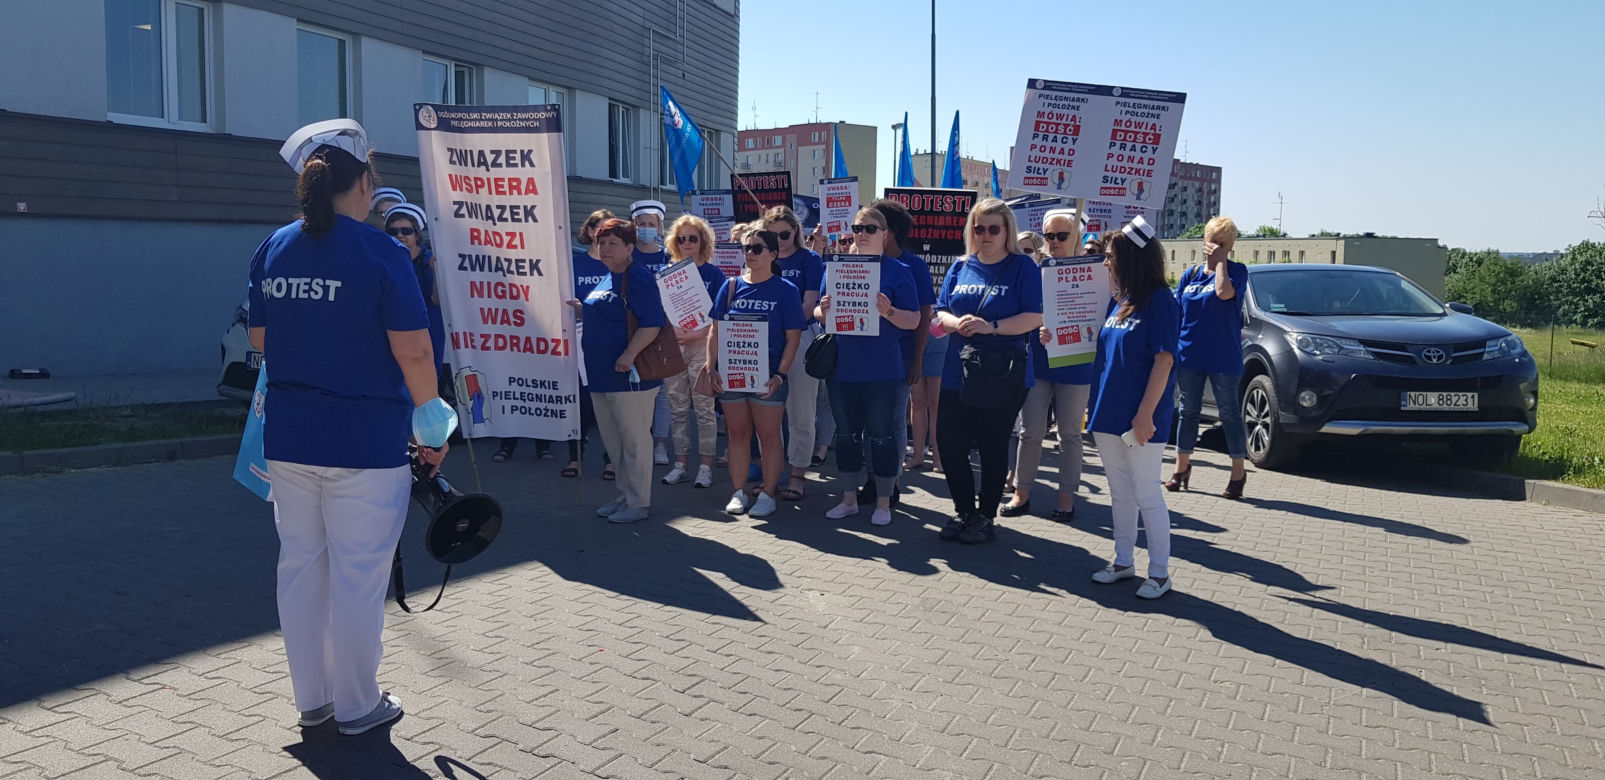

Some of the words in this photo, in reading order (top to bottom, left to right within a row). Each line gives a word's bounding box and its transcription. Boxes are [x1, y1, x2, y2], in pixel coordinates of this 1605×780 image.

[1038, 94, 1088, 104] PIELĘGNIARKI
[1047, 103, 1080, 111] POŁOŻNE
[1115, 100, 1169, 112] PIELĘGNIARKI
[438, 111, 480, 120] OGÓLNOPOLSKI
[482, 112, 512, 120] ZWIĄZEK
[1036, 110, 1082, 124] MÓWIĄ:
[1124, 110, 1161, 119] POŁOŻNE
[1039, 123, 1074, 135] DOŚĆ
[1113, 118, 1162, 132] MÓWIĄ:
[1032, 133, 1078, 145] PRACY
[1116, 132, 1154, 143] DOŚĆ
[1030, 144, 1075, 156] PONAD
[1108, 141, 1160, 154] PRACY
[447, 147, 535, 172] ZWIĄZEK
[1028, 155, 1074, 168] LUDZKIE
[1106, 153, 1155, 165] PONAD
[1025, 166, 1048, 176] SIŁY
[1104, 164, 1154, 177] LUDZKIE
[448, 174, 539, 196] WSPIERA
[734, 175, 788, 190] PROTEST!
[1102, 175, 1127, 186] SIŁY
[453, 201, 539, 226] ZWIĄZEK
[470, 228, 525, 250] RADZI
[458, 253, 543, 277] ZWIĄZEK
[1058, 266, 1092, 275] GODNA
[664, 269, 687, 284] GODNA
[1058, 274, 1093, 283] PŁACA
[262, 277, 342, 301] PROTEST
[470, 281, 530, 302] NIGDY
[836, 282, 870, 290] CIĘŻKO
[480, 307, 526, 327] WAS
[451, 331, 476, 350] NIE
[480, 334, 569, 356] ZDRADZI
[727, 340, 759, 349] CIĘŻKO
[509, 376, 559, 390] POLSKIE
[492, 391, 576, 405] PIELĘGNIARKI
[1408, 394, 1432, 406] NOL
[1437, 394, 1475, 406] 88231
[502, 406, 505, 415] I
[511, 405, 567, 418] POŁOŻNE
